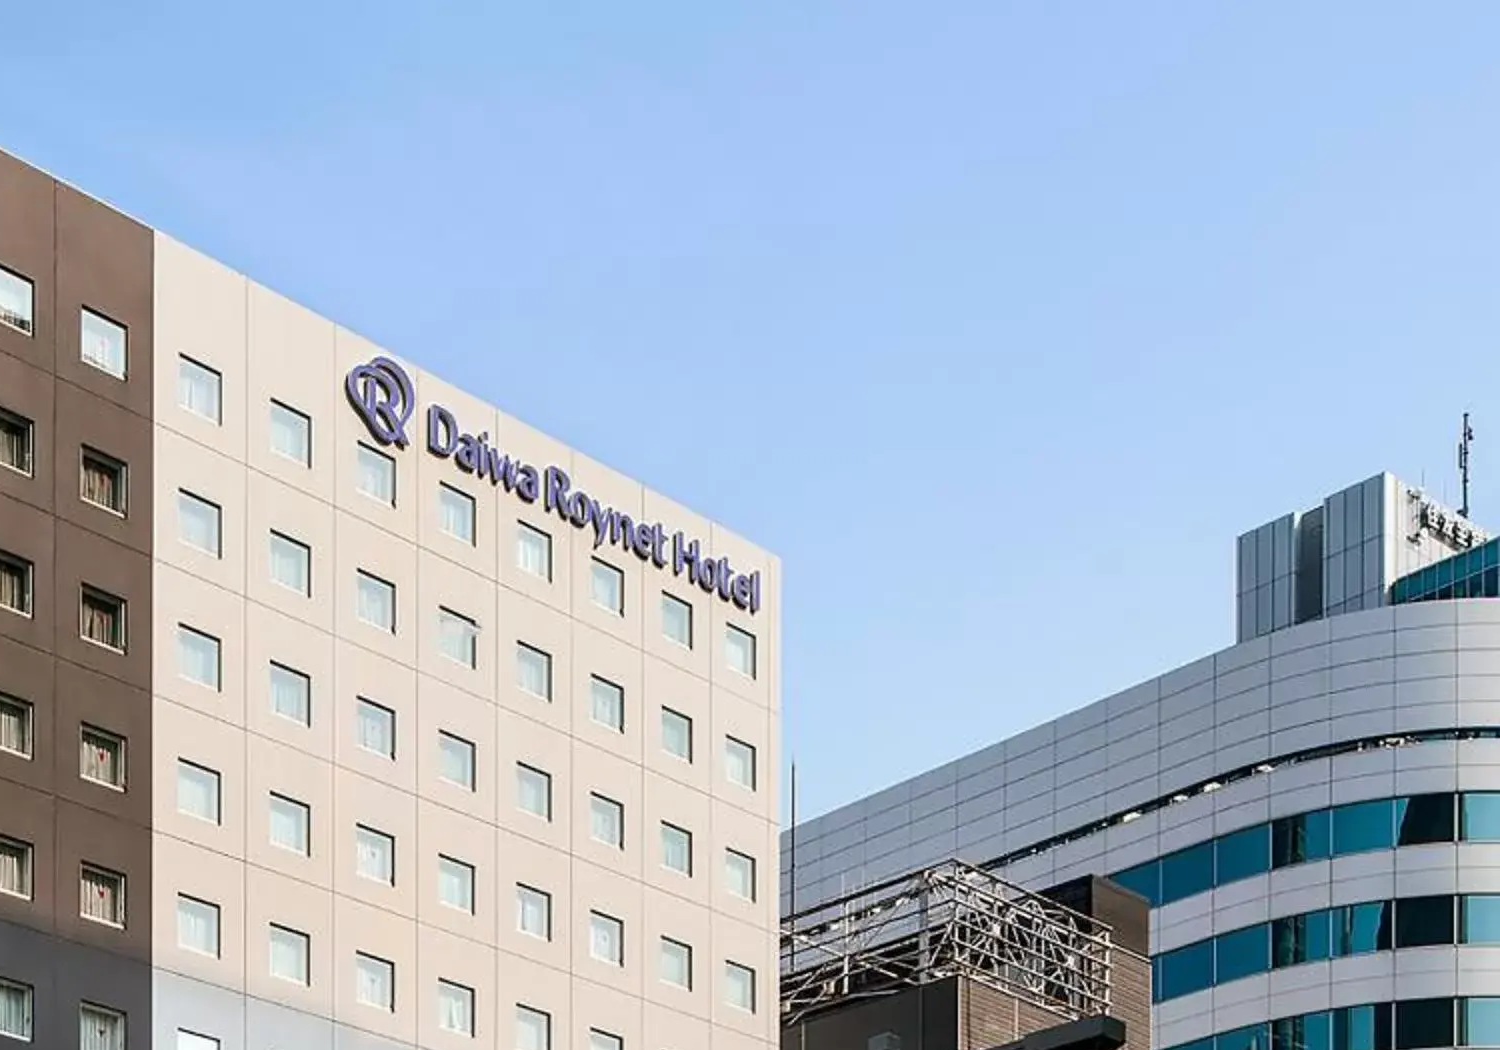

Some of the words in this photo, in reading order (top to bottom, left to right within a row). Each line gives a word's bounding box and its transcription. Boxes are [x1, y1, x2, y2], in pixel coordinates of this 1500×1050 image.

[427, 404, 540, 503] Daiwa
[544, 466, 669, 570] Roynet
[673, 531, 761, 613] Hotel
